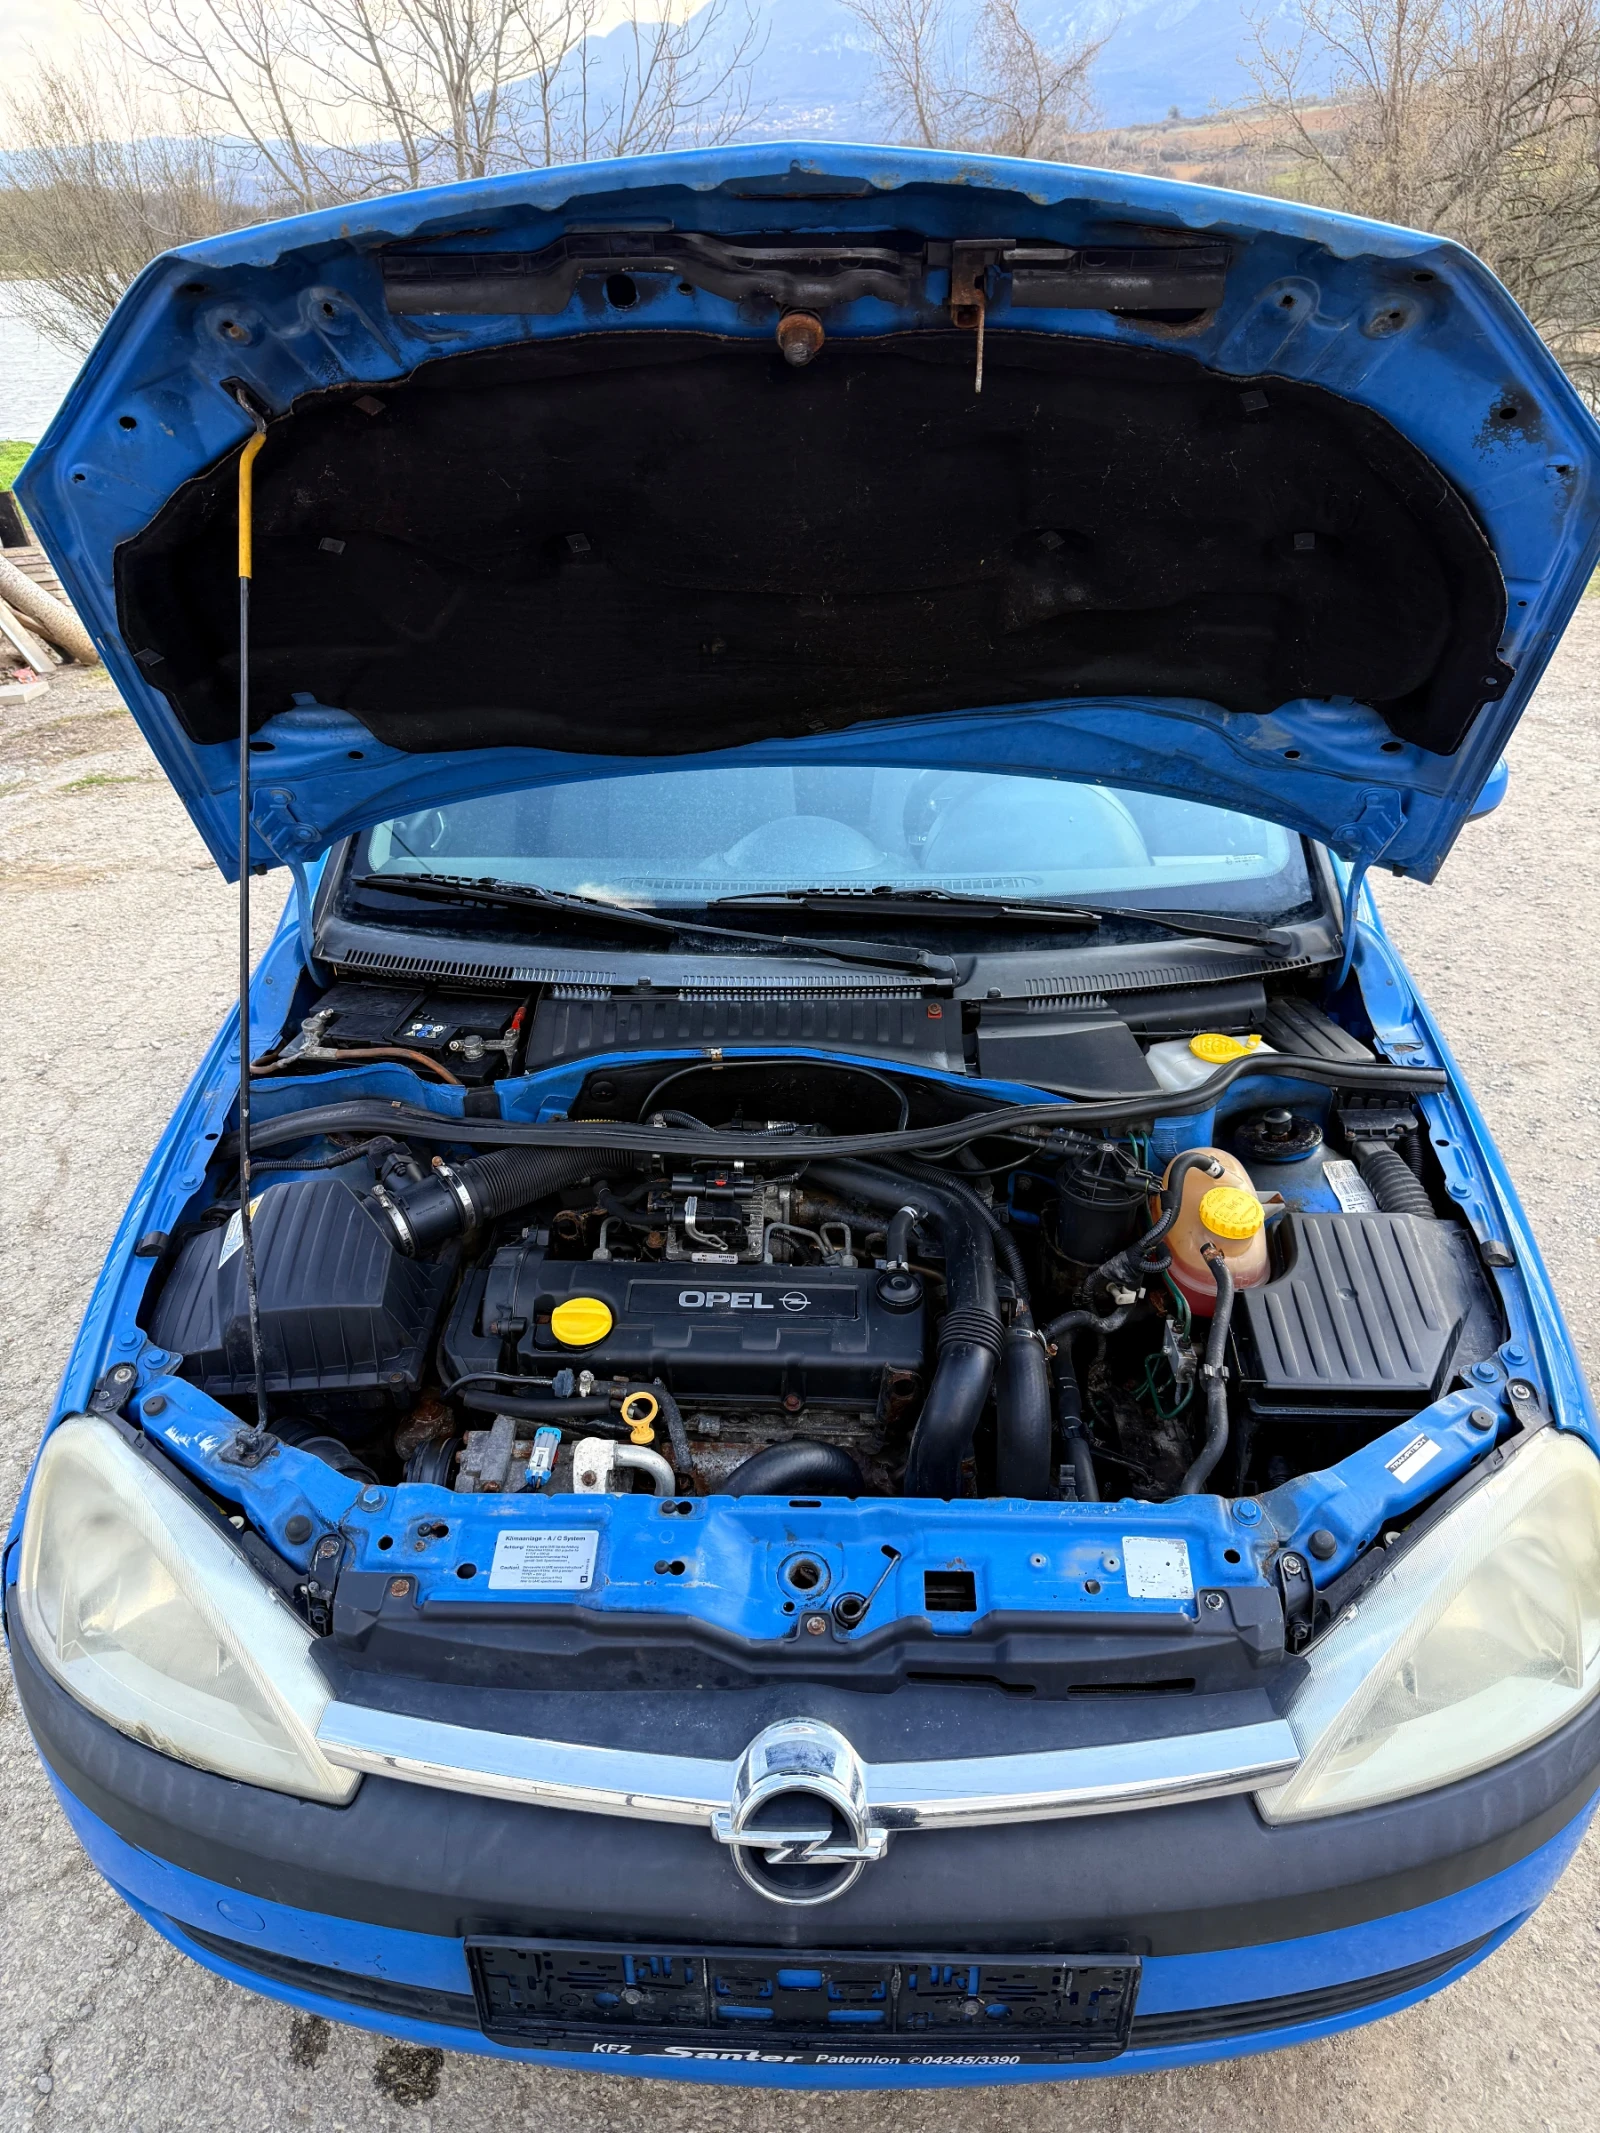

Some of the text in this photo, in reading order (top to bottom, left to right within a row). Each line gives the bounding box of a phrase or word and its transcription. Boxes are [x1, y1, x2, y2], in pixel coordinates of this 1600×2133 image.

[679, 1291, 774, 1309] OPEL
[592, 2043, 1021, 2065] KFZ Santer Paternion 04245/3390
